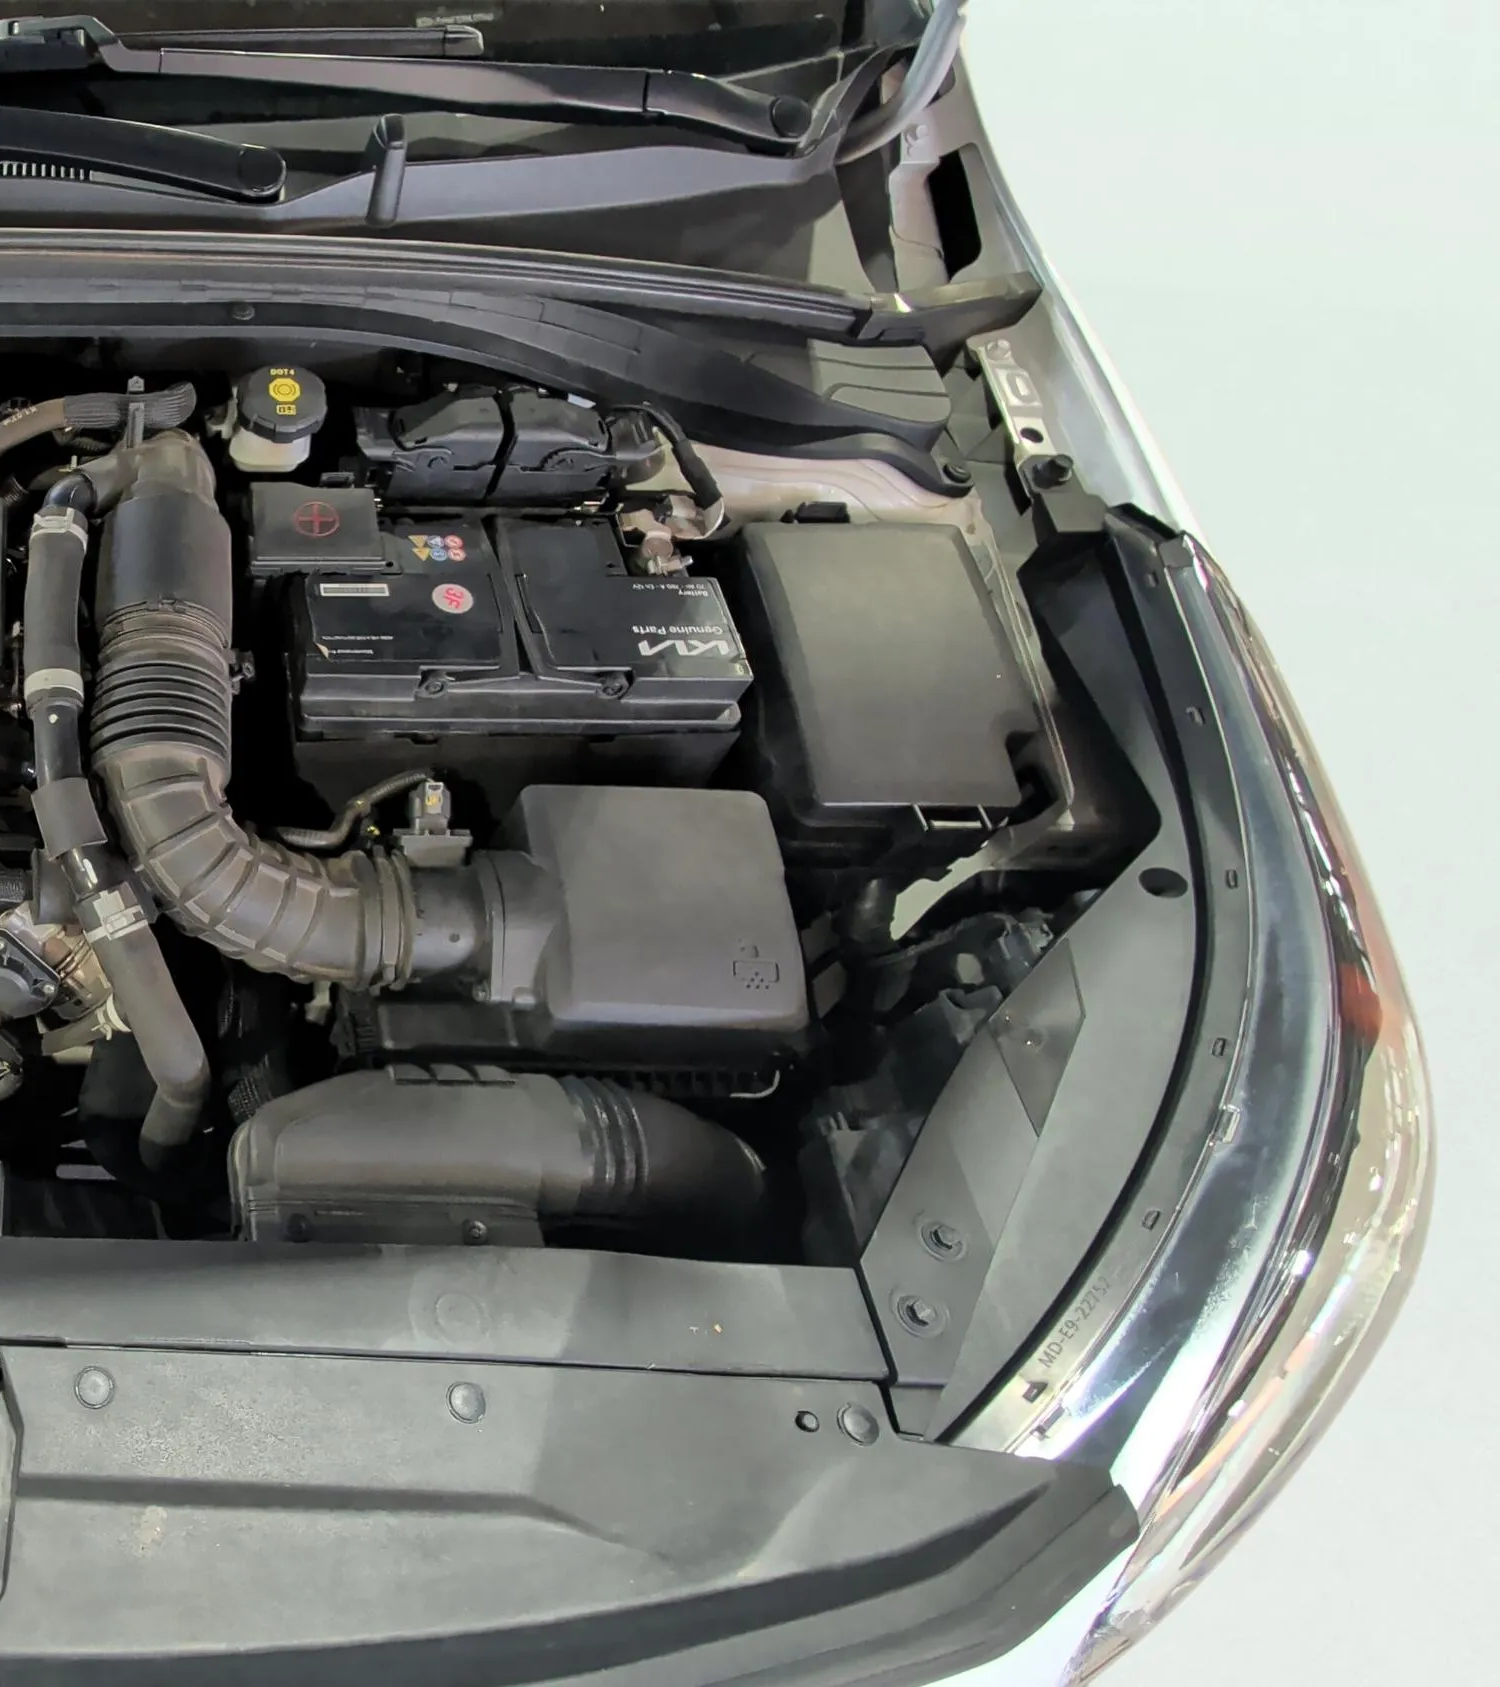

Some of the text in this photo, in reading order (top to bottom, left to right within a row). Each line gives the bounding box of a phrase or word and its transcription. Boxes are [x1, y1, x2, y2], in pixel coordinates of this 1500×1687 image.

[632, 625, 723, 635] Genuine Parts
[638, 640, 730, 656] KIA
